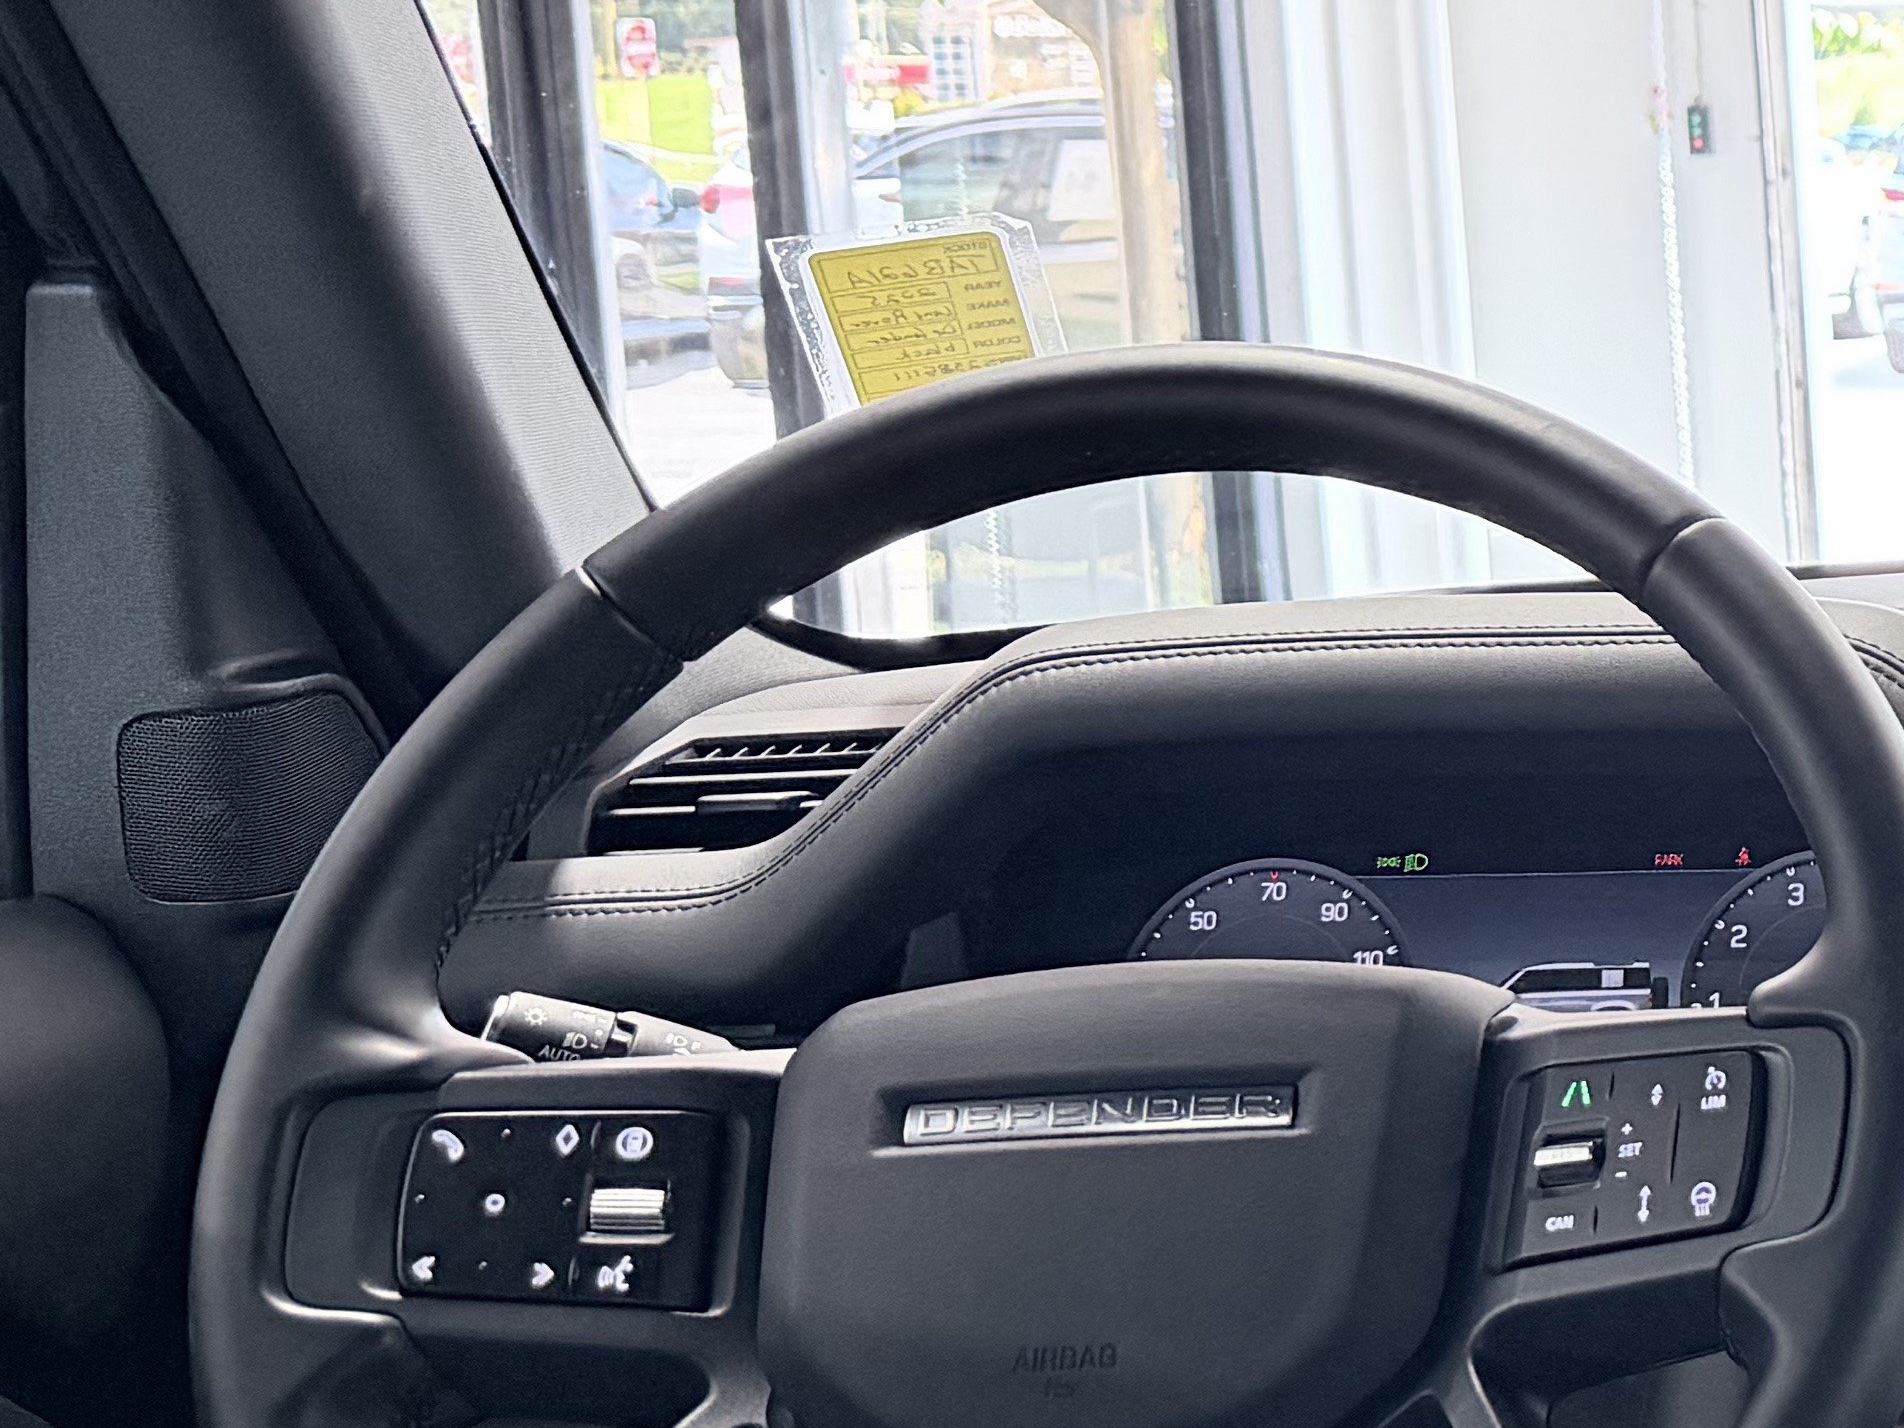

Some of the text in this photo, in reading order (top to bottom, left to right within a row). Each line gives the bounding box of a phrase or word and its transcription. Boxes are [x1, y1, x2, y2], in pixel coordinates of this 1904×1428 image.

[1260, 882, 1287, 901] 70
[1787, 883, 1805, 906] 3
[1189, 911, 1217, 930] 50
[1321, 903, 1348, 922] 90
[1730, 925, 1748, 948] 2
[1353, 950, 1384, 967] 110
[917, 1092, 1281, 1138] DEFENDER
